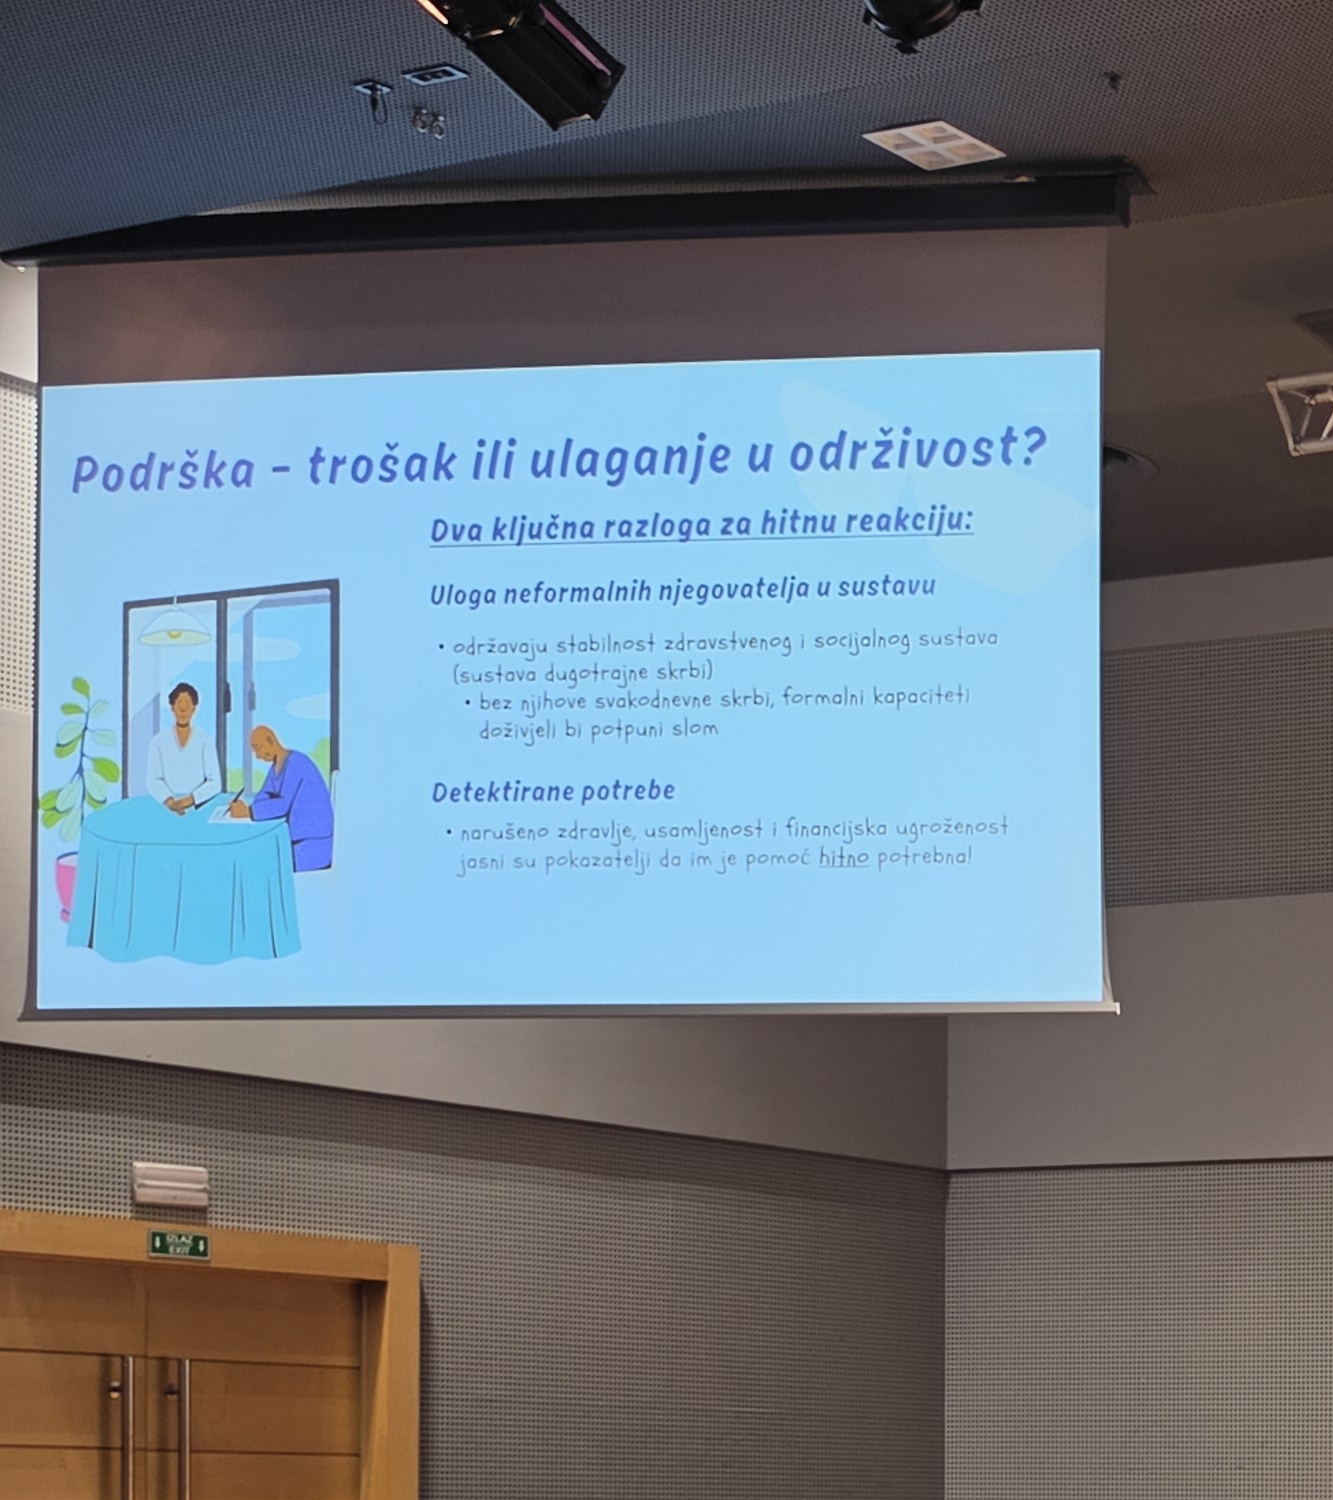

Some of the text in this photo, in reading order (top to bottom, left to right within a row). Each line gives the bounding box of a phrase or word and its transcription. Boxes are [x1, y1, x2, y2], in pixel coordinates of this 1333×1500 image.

[71, 448, 255, 494] Podrška
[308, 440, 458, 486] trošak
[471, 436, 518, 481] ili
[530, 431, 732, 488] ulaganje
[747, 442, 774, 474] u
[789, 424, 1047, 472] održivost?
[430, 503, 975, 548] Dva ključna razloga za hitnu reakciju:
[430, 573, 937, 611] Uloga neformalnih njegovatelja u sustavu
[452, 626, 998, 663] održavaju stabilnost zdravstvenog i socijalnog sustava
[452, 658, 713, 690] (sustava dugotrajne skrbi)
[479, 683, 970, 719] bez njihove svakodnevne skrbi, formalni kapaciteti
[478, 716, 719, 748] doživjeli bi potpuni slom
[431, 777, 676, 807] Detektirane potrebe
[460, 814, 1008, 848] narušeno zdravlje, usamljenost i financijska ugroženost
[455, 844, 972, 878] jasni su pokazatelji da im je pomoć hitno potrebna!
